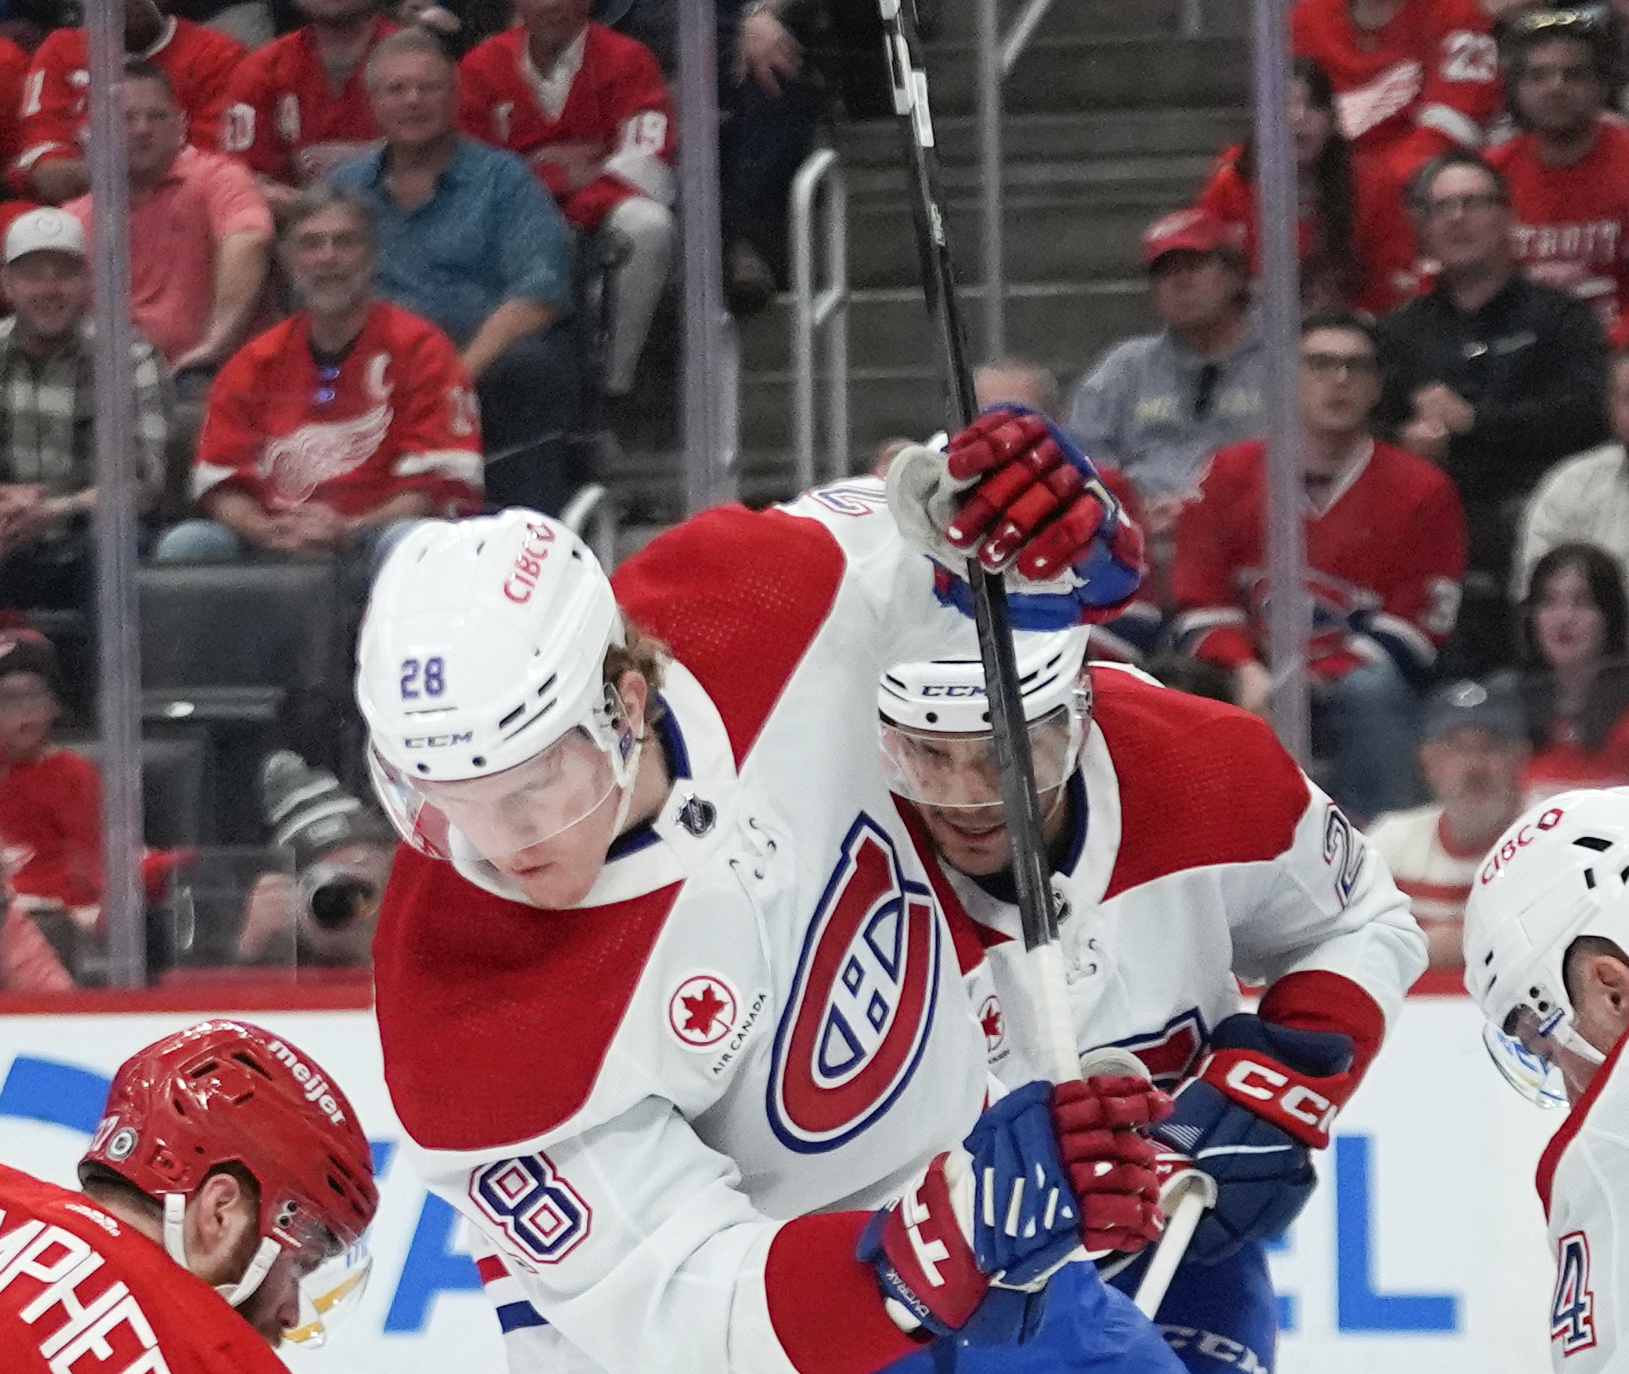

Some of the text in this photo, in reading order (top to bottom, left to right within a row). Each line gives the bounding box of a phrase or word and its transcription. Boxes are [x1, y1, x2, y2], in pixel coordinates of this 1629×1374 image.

[400, 656, 446, 700] 28
[403, 730, 473, 749] CCM
[712, 993, 768, 1076] AIR CANADA
[270, 1040, 347, 1127] meijer
[884, 1266, 931, 1319] DVORAK
